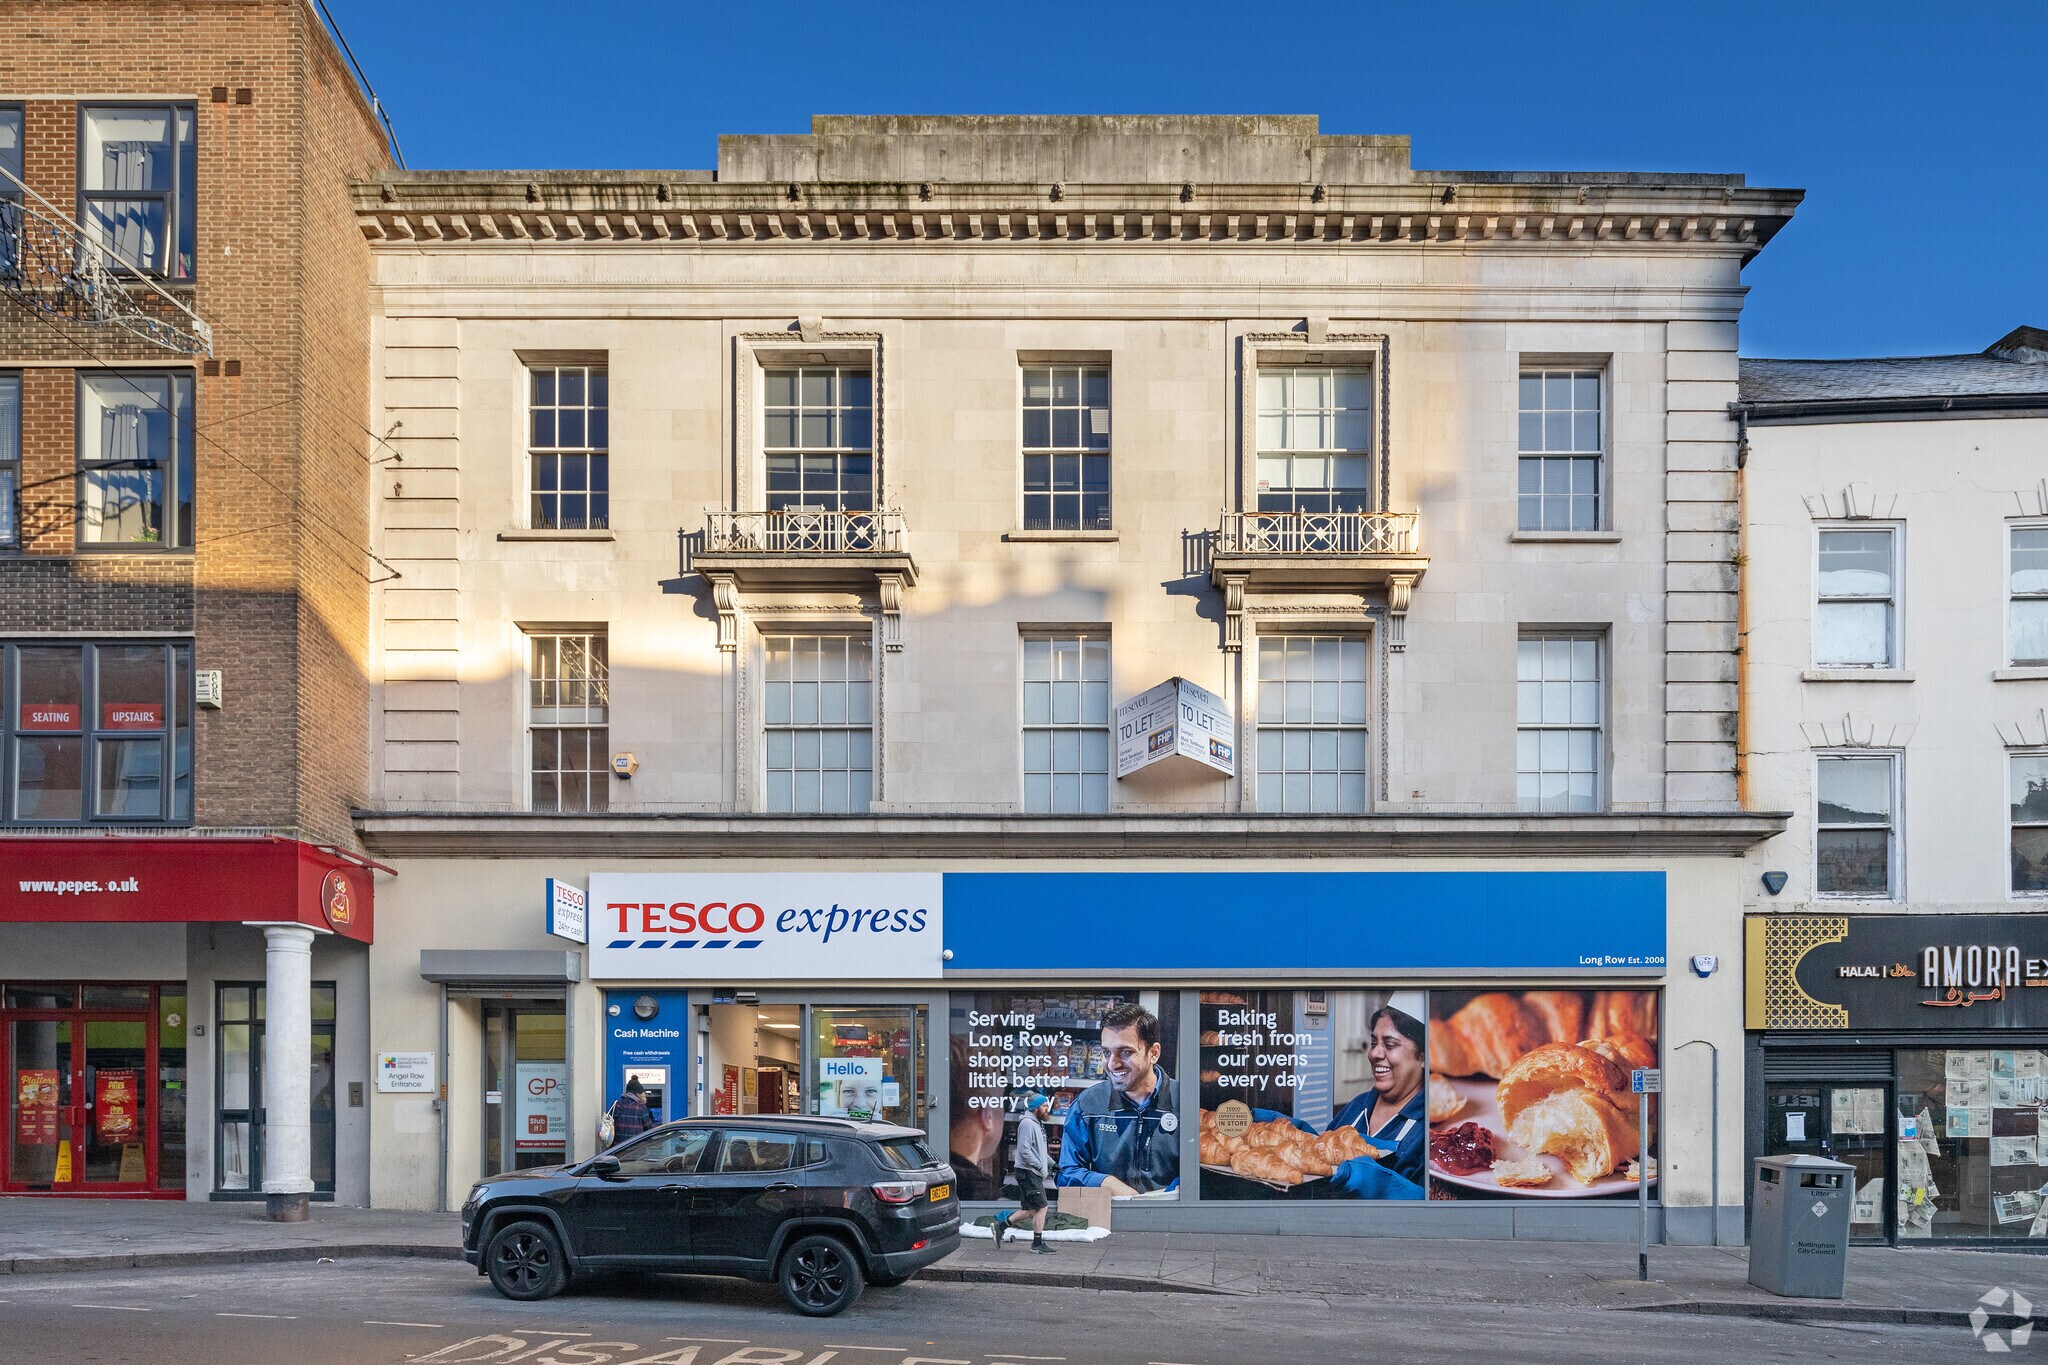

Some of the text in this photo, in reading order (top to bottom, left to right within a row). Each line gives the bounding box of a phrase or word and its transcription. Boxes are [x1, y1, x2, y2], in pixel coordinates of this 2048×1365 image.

[33, 712, 69, 722] SEATING
[113, 712, 154, 722] UPSTAIRS
[1181, 702, 1193, 722] TO
[1197, 710, 1214, 732] LET
[1120, 724, 1132, 740] TO
[1136, 712, 1154, 734] LET
[1158, 731, 1172, 746] FHP
[1218, 745, 1230, 758] FHP
[19, 877, 138, 895] www.pepes.o.uk
[557, 886, 584, 906] TESCO
[558, 908, 582, 923] express
[606, 902, 927, 944] TESCO express
[1580, 956, 1602, 966] Long
[1605, 956, 1626, 964] Row
[1924, 946, 2020, 986] AMORA
[1840, 967, 1879, 977] HALAL
[968, 1011, 1035, 1030] Serving
[1218, 1010, 1277, 1029] Baking
[614, 1029, 679, 1038] Cash Machine
[969, 1032, 1013, 1050] Long
[1218, 1030, 1312, 1046] fresh from
[968, 1052, 1068, 1071] shoppers a
[1218, 1053, 1308, 1067] our ovens
[827, 1063, 868, 1075] Hello.
[968, 1072, 1069, 1088] little better
[1218, 1071, 1307, 1091] every day
[968, 1096, 1019, 1110] every
